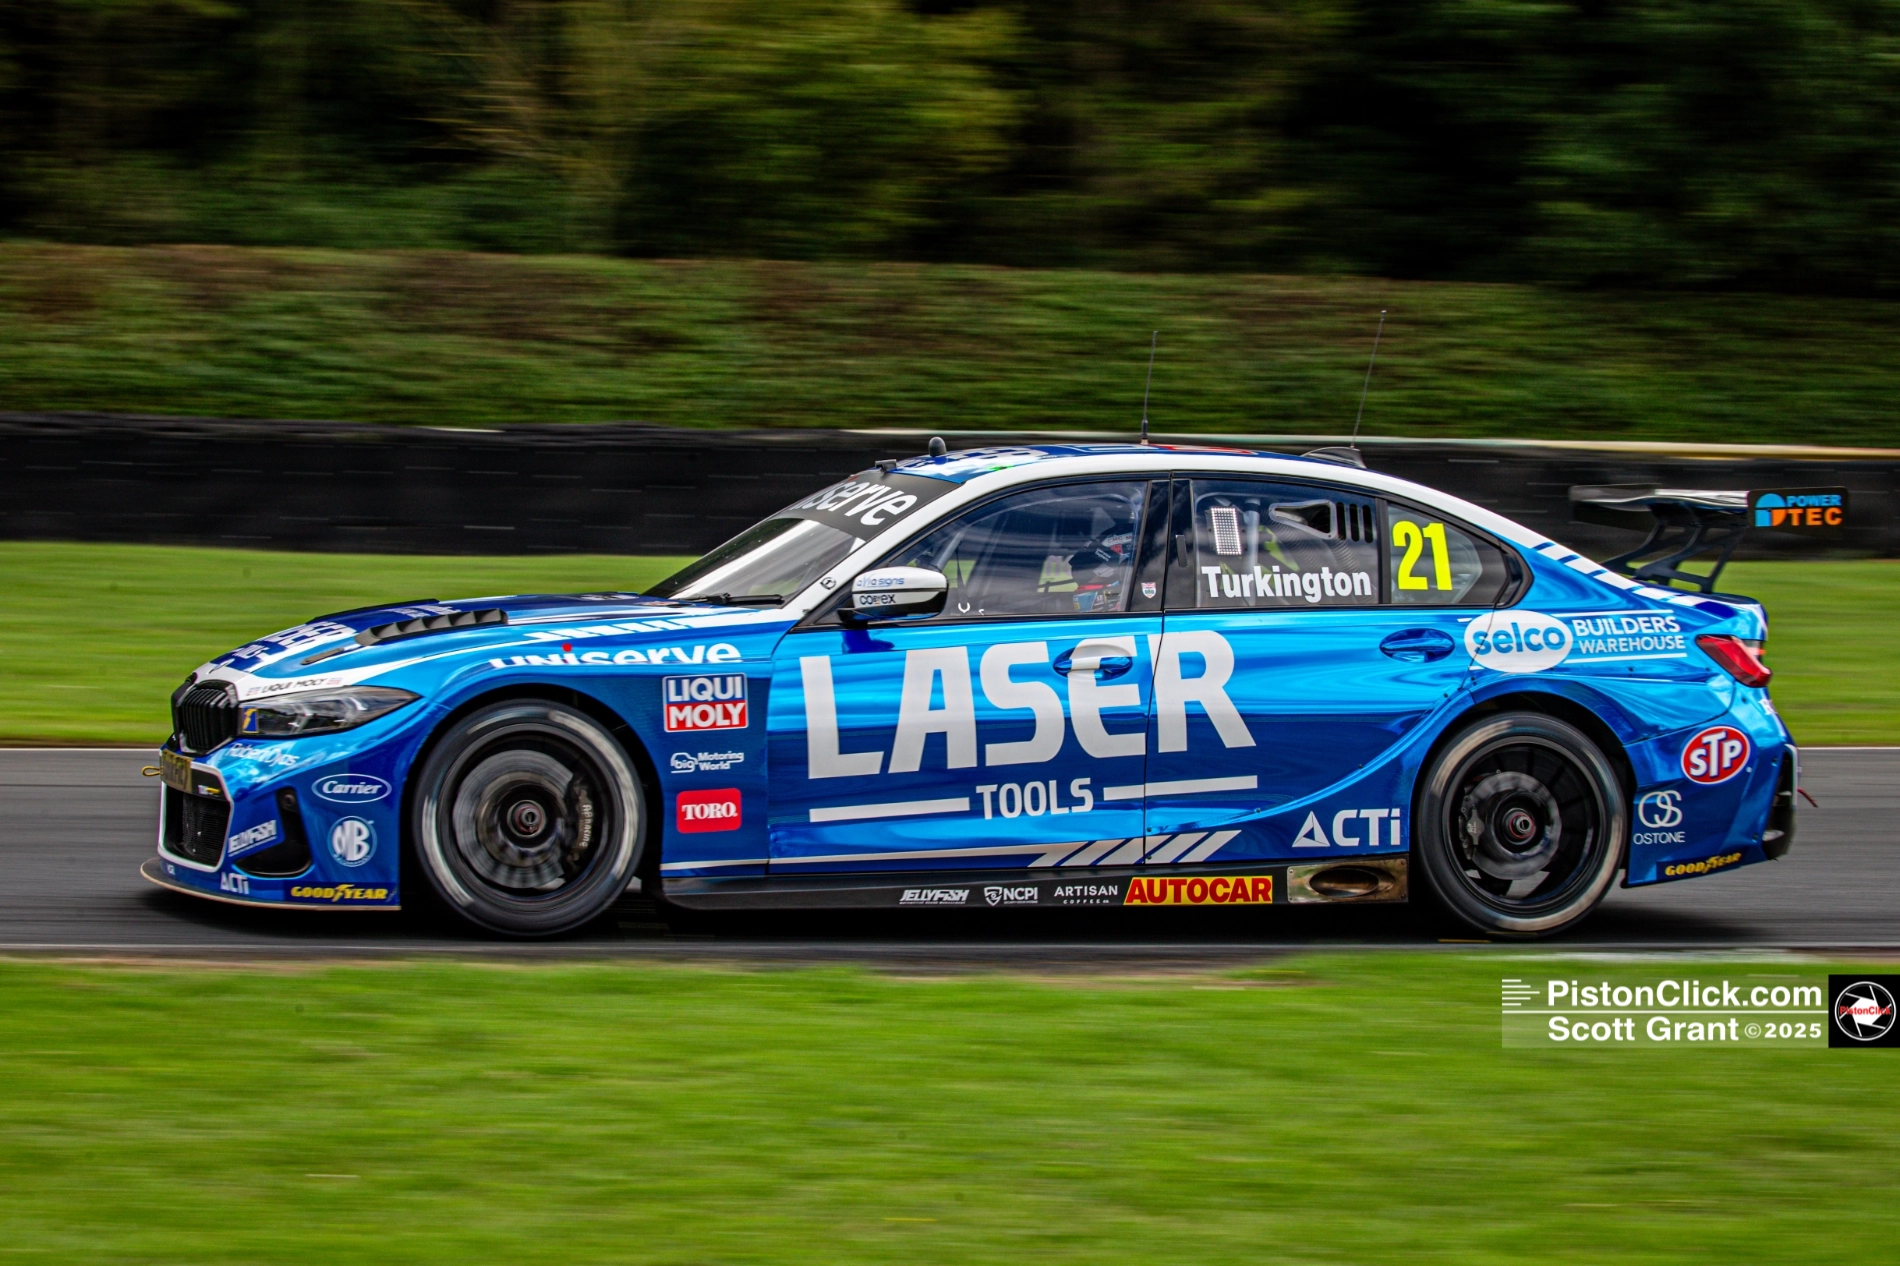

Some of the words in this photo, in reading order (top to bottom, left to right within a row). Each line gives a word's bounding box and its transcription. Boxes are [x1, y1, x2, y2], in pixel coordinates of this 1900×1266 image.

[1786, 494, 1842, 507] POWER
[1787, 507, 1843, 526] TEC
[1392, 520, 1453, 591] 21
[1201, 565, 1372, 603] Turkington
[1571, 616, 1681, 637] BUILDERS
[1472, 621, 1566, 656] selco
[1578, 635, 1686, 654] WAREHOUSE
[668, 676, 743, 702] LIQUI
[799, 630, 1257, 779] LASER
[668, 702, 746, 729] MOLY
[697, 751, 744, 762] Motoring
[1689, 730, 1743, 778] STP
[698, 761, 731, 771] World
[322, 780, 382, 794] Carrier
[976, 777, 1094, 820] TOOLS
[682, 801, 737, 820] TORO
[1633, 831, 1686, 845] OSTONE
[1664, 852, 1742, 876] GOODYEAR
[290, 884, 388, 903] GOODYEAR
[899, 889, 970, 901] JELLYFISH
[1003, 887, 1038, 900] NCPI
[1054, 885, 1118, 897] ARTISAN
[1125, 877, 1272, 904] AUTOCAR
